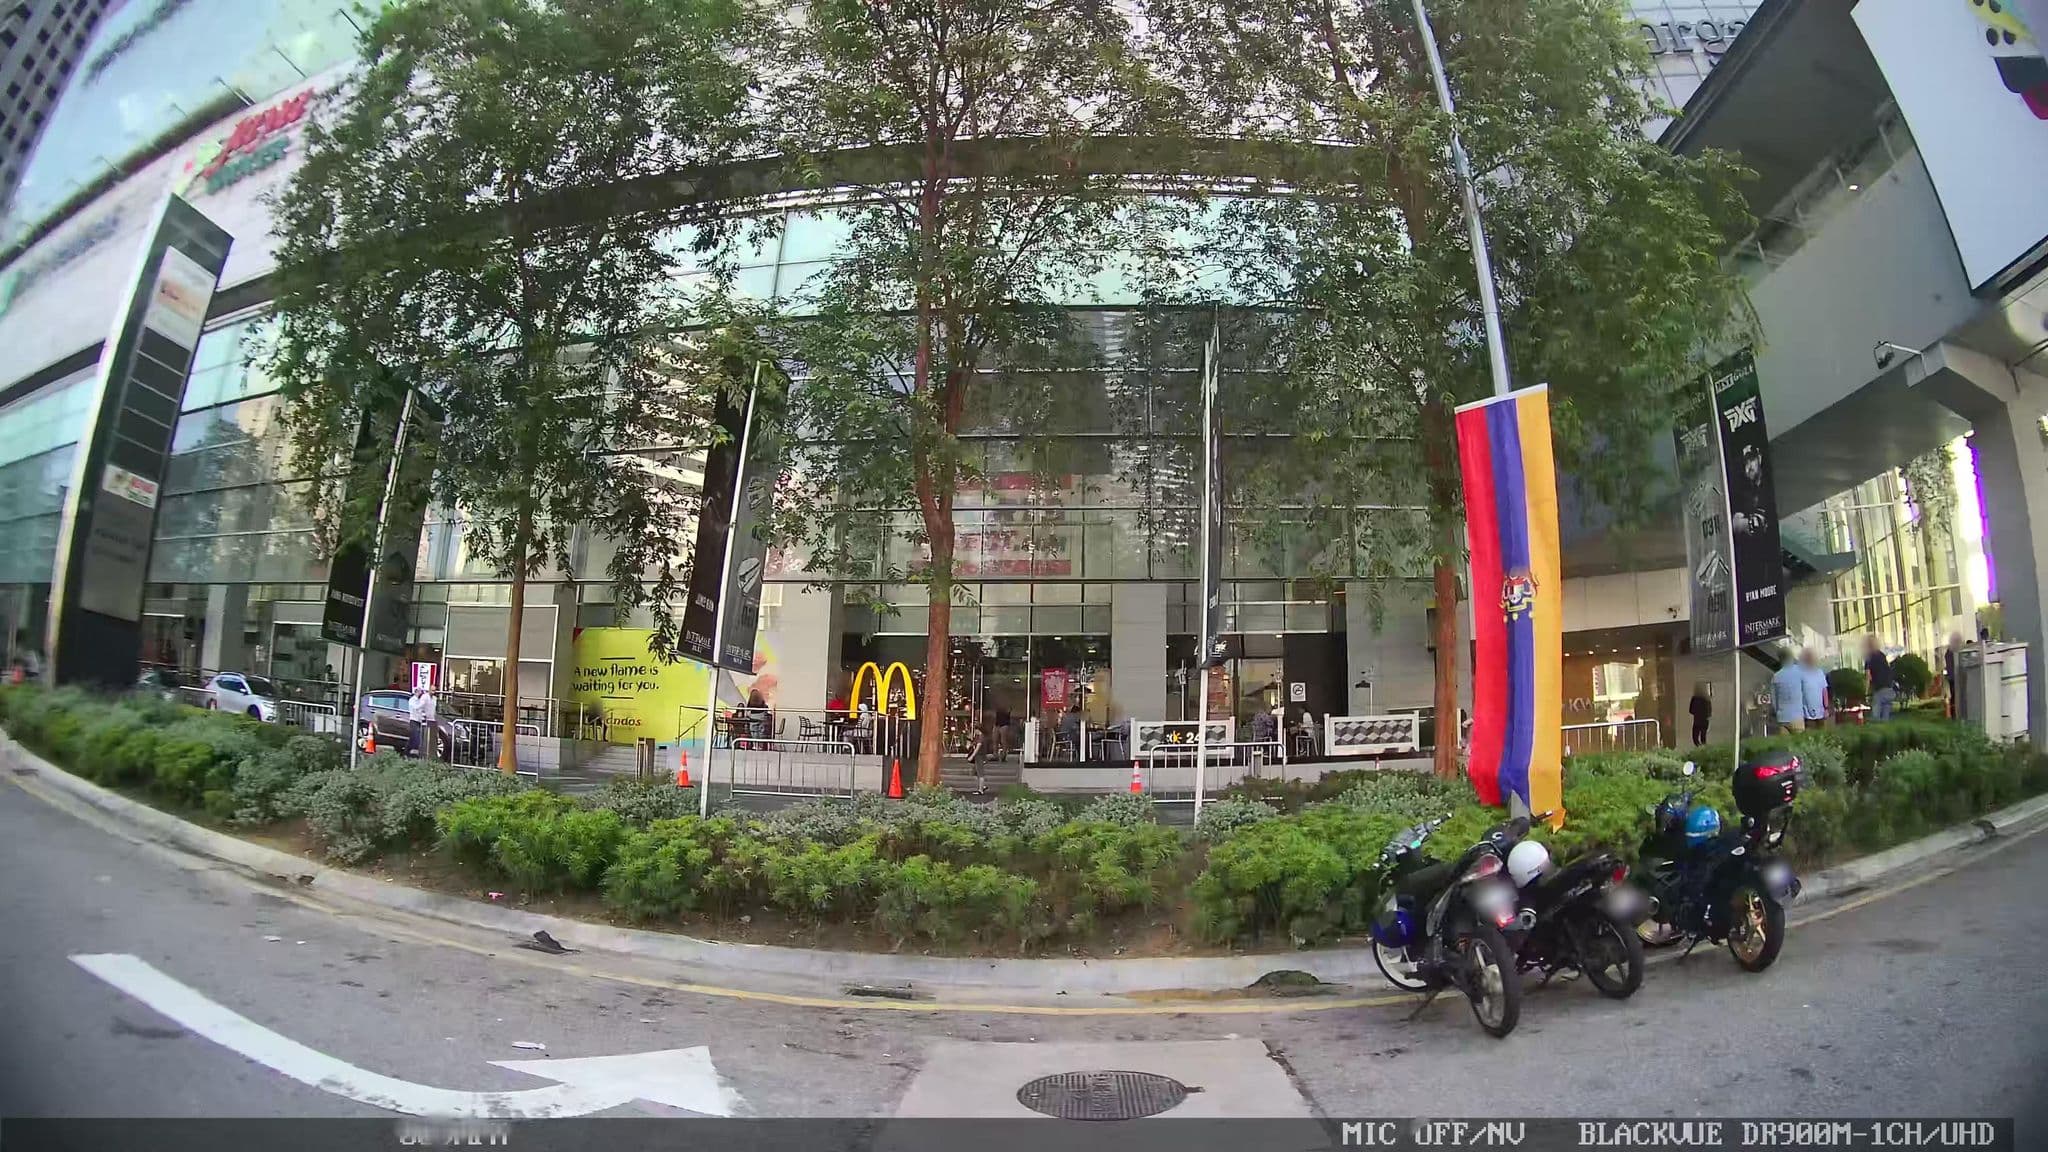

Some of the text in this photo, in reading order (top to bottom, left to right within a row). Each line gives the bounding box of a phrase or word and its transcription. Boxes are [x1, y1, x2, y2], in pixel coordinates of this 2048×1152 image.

[574, 663, 658, 677] A new flame is
[573, 679, 659, 694] waiting for you.
